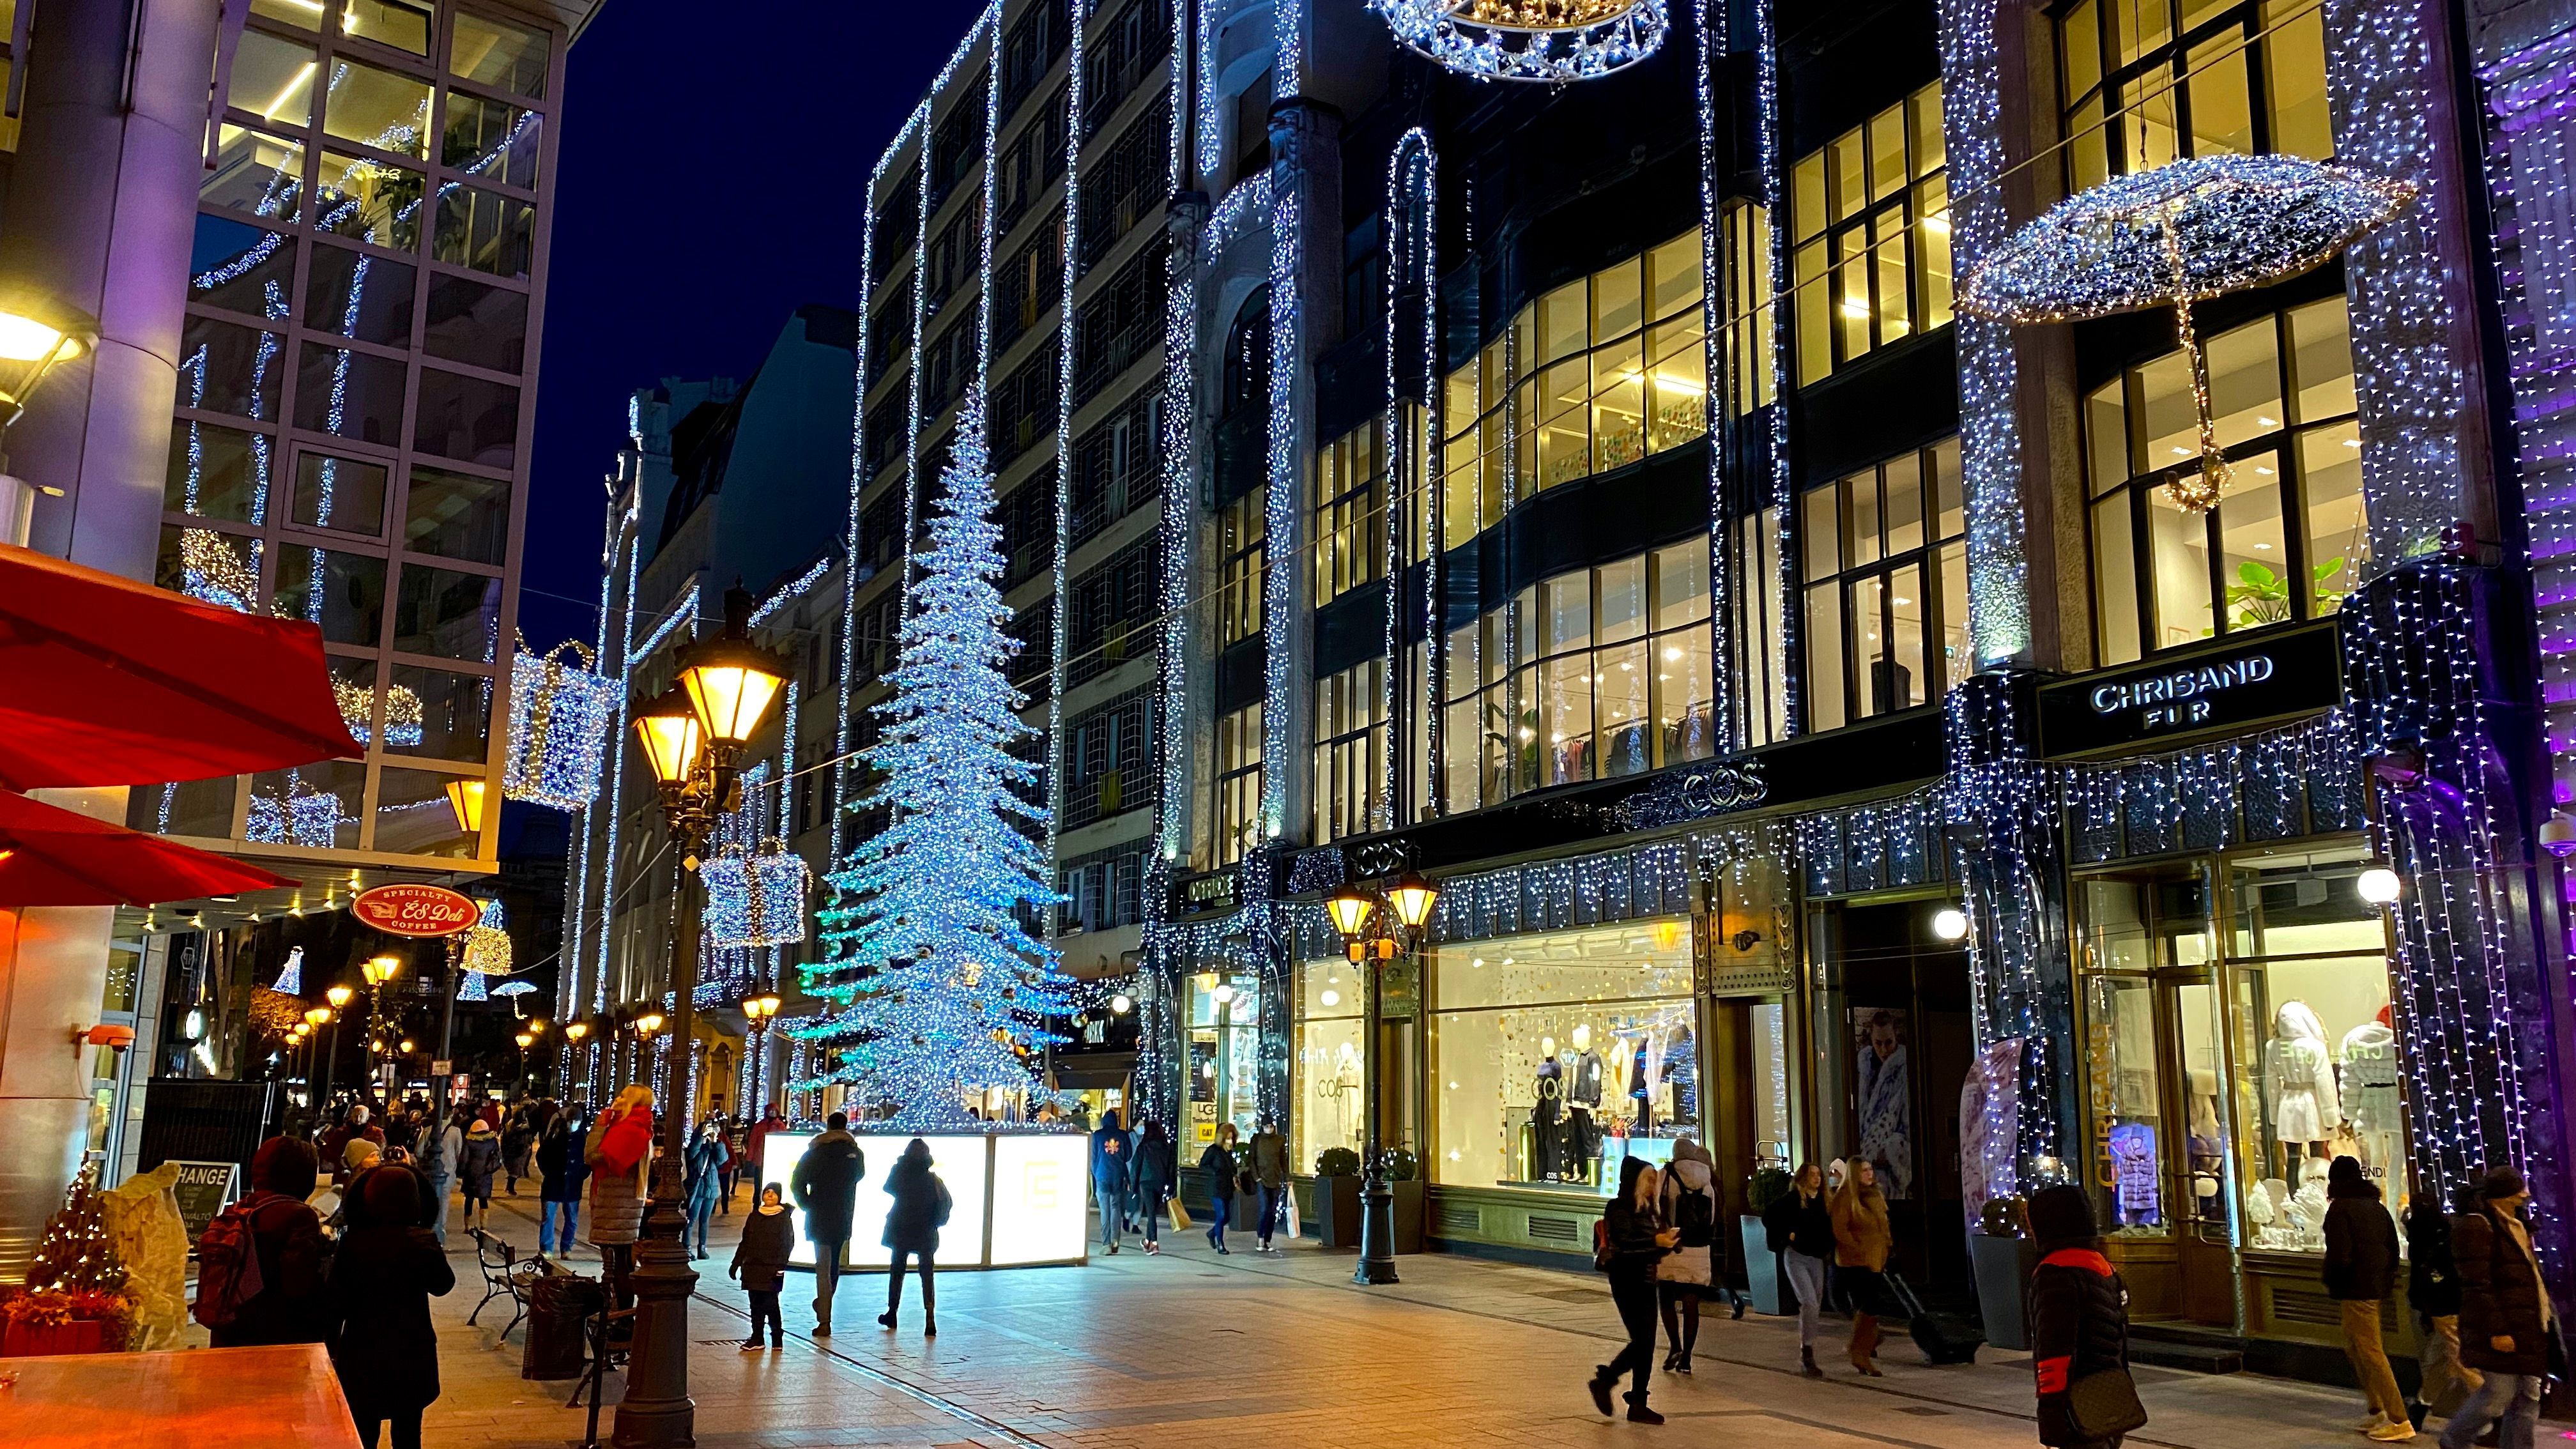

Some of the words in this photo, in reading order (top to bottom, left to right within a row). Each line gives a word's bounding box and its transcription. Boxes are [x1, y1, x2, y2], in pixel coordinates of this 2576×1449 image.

[2090, 655, 2274, 713] CHRISAND
[2143, 700, 2211, 730] FUR
[1681, 762, 1768, 811] COS
[383, 889, 452, 902] SPECIALTY
[401, 900, 431, 919] ÉS
[428, 903, 466, 922] Deli
[391, 920, 437, 930] COFFEE
[1531, 1077, 1568, 1101] COS
[2089, 1023, 2119, 1188] CHRISAND
[178, 1167, 228, 1185] HANGE
[2361, 1166, 2386, 1178] ENDI
